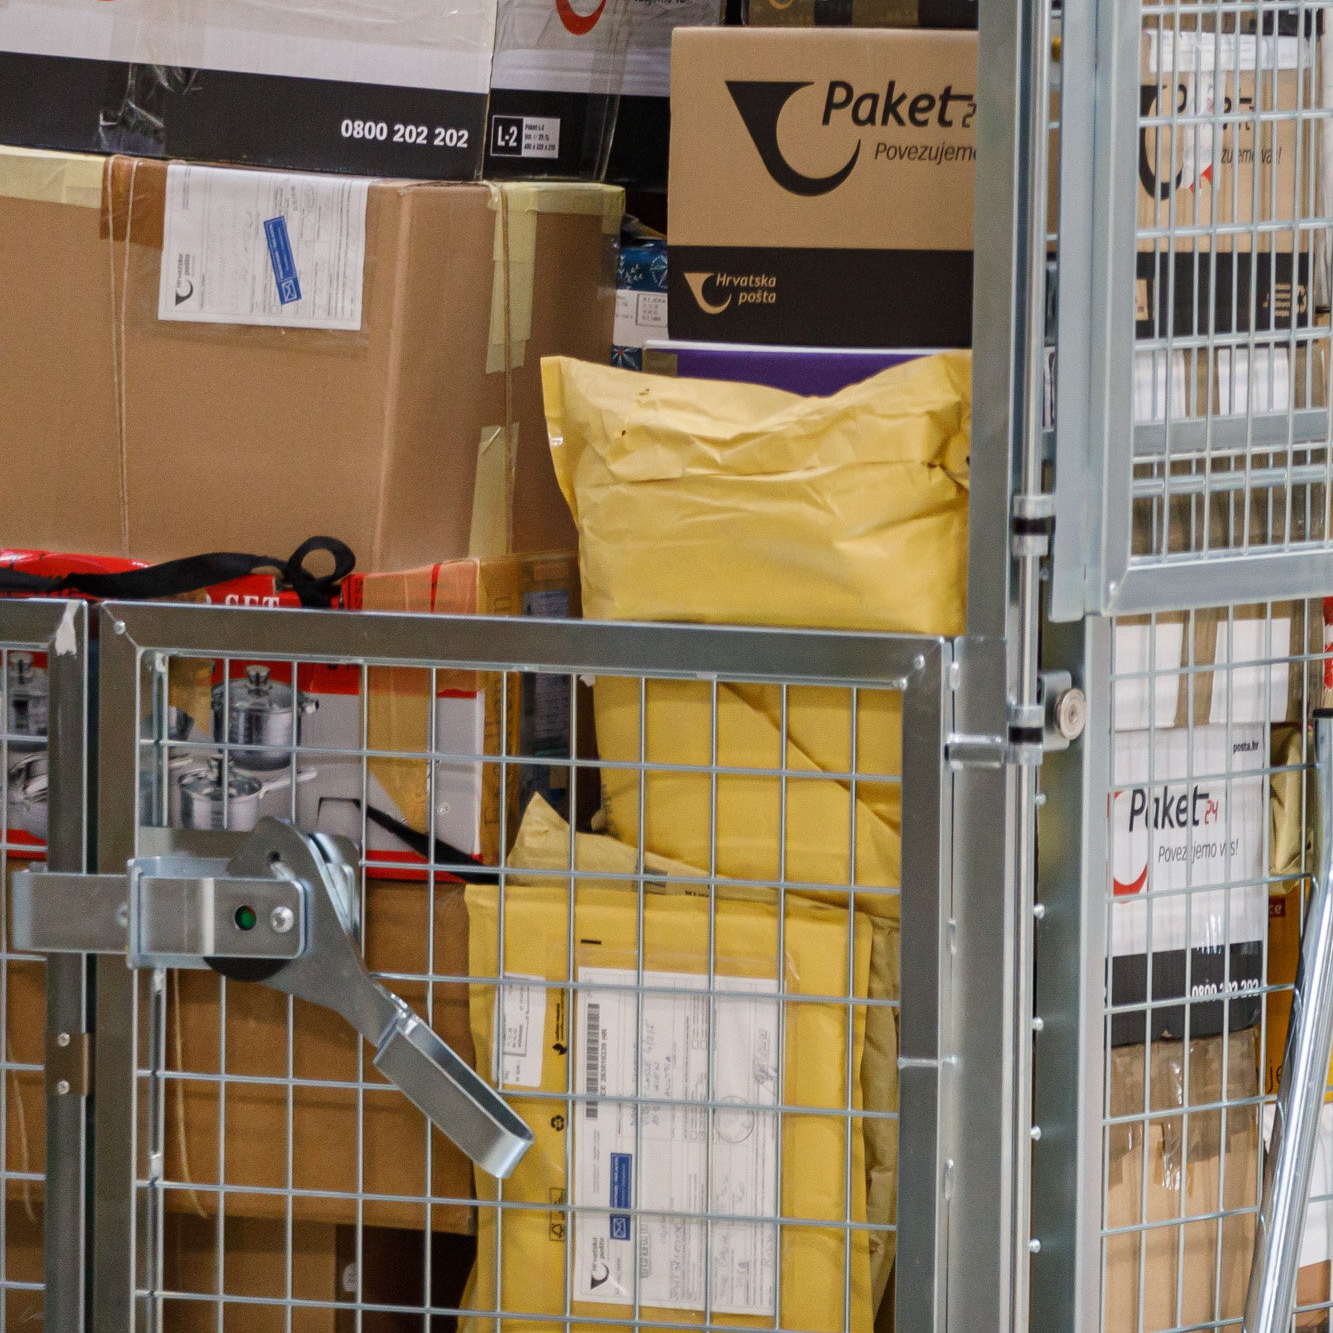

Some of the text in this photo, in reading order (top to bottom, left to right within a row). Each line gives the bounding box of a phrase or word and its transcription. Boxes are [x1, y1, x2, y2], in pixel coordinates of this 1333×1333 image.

[822, 79, 975, 128] Paket
[340, 118, 470, 149] 0800 202 202
[496, 125, 519, 147] L-2
[715, 272, 777, 288] Hrvatska
[737, 289, 777, 306] pošta
[1232, 740, 1260, 754] posta.hr
[1204, 799, 1220, 826] 24
[1158, 837, 1239, 865] Povezjemo vs!
[591, 1236, 599, 1273] Hrvatska
[598, 1237, 606, 1260] pošta
